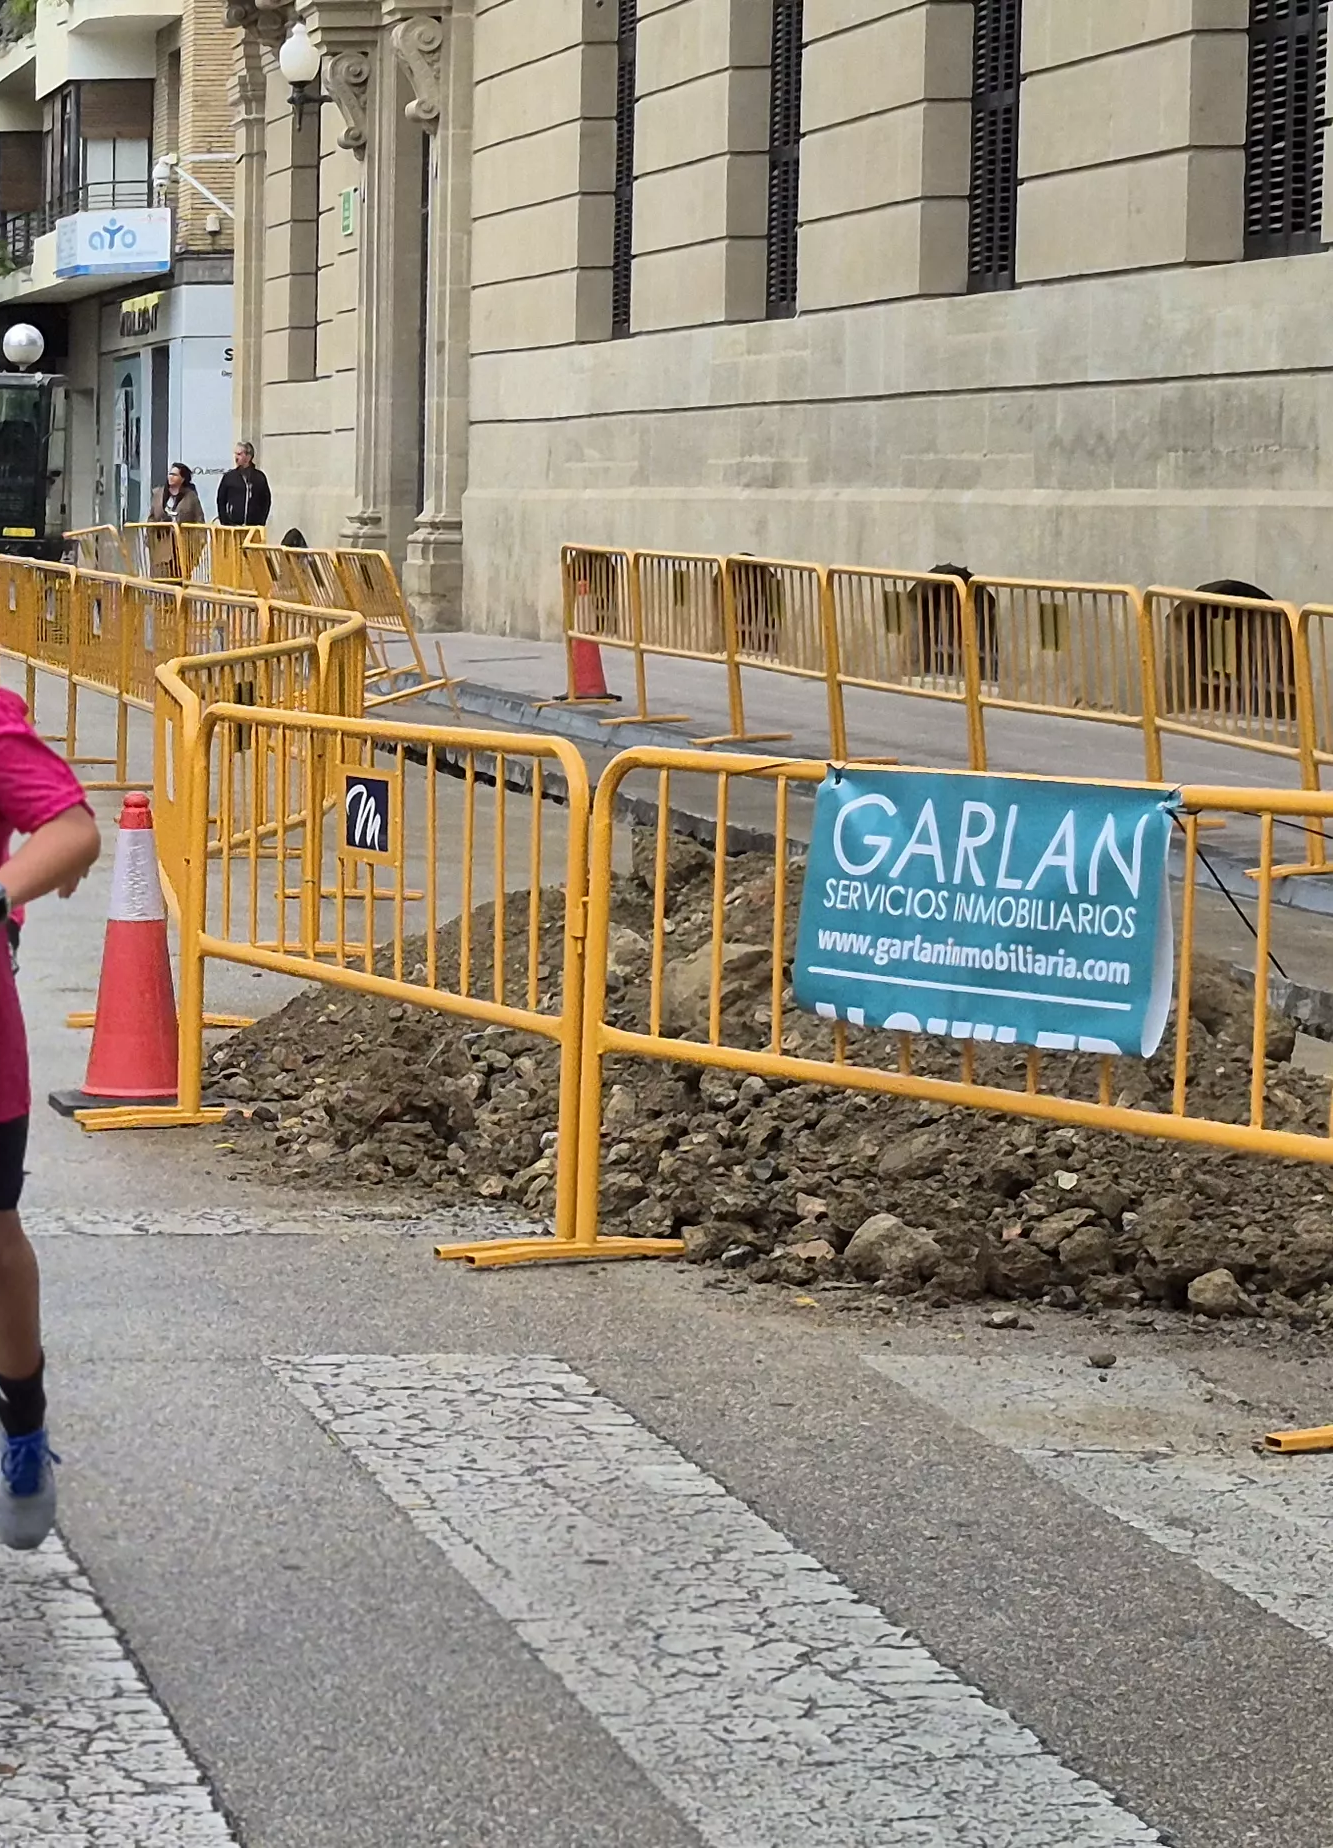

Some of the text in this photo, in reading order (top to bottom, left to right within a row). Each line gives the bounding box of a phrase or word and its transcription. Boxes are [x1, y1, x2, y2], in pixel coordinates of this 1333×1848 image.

[833, 793, 1150, 900] GARLAN
[823, 877, 1137, 939] SERVICIOS INMOBILIARIOS
[818, 927, 1131, 986] www.garlaninmobiliaria.com
